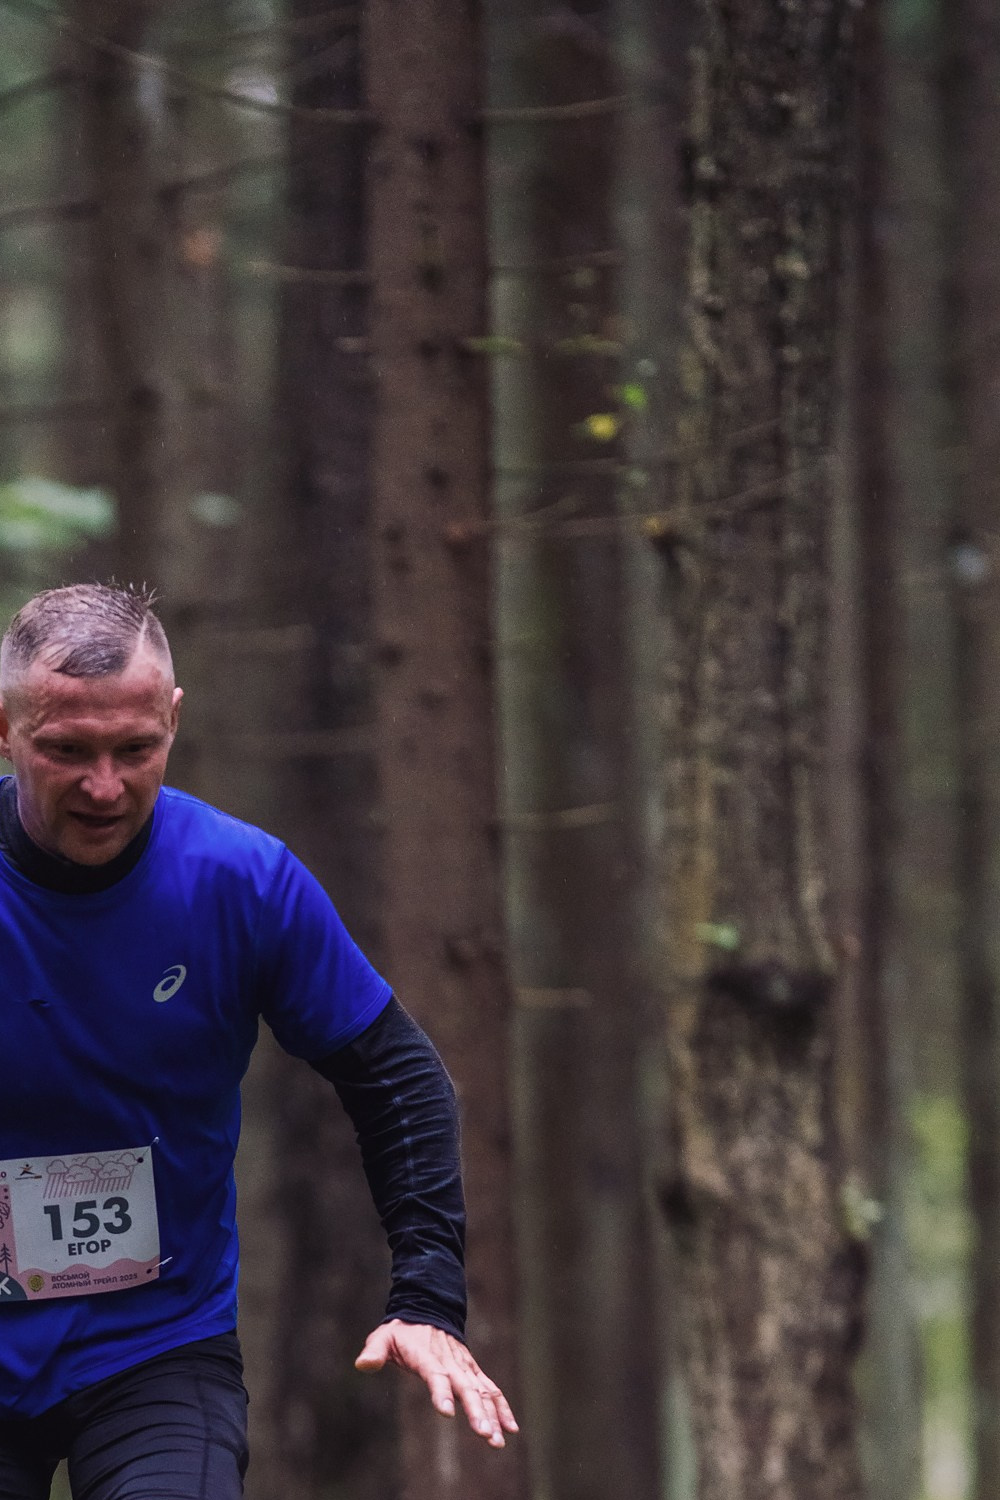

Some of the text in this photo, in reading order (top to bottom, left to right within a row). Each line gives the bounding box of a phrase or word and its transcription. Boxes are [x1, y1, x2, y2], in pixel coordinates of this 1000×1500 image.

[43, 1196, 132, 1241] 153
[67, 1239, 112, 1256] ЕГОР
[51, 1271, 89, 1282] ВОСЬМОЙ
[51, 1279, 91, 1290] АТОМНЫЙ
[93, 1276, 117, 1285] ТРЕЙЛ
